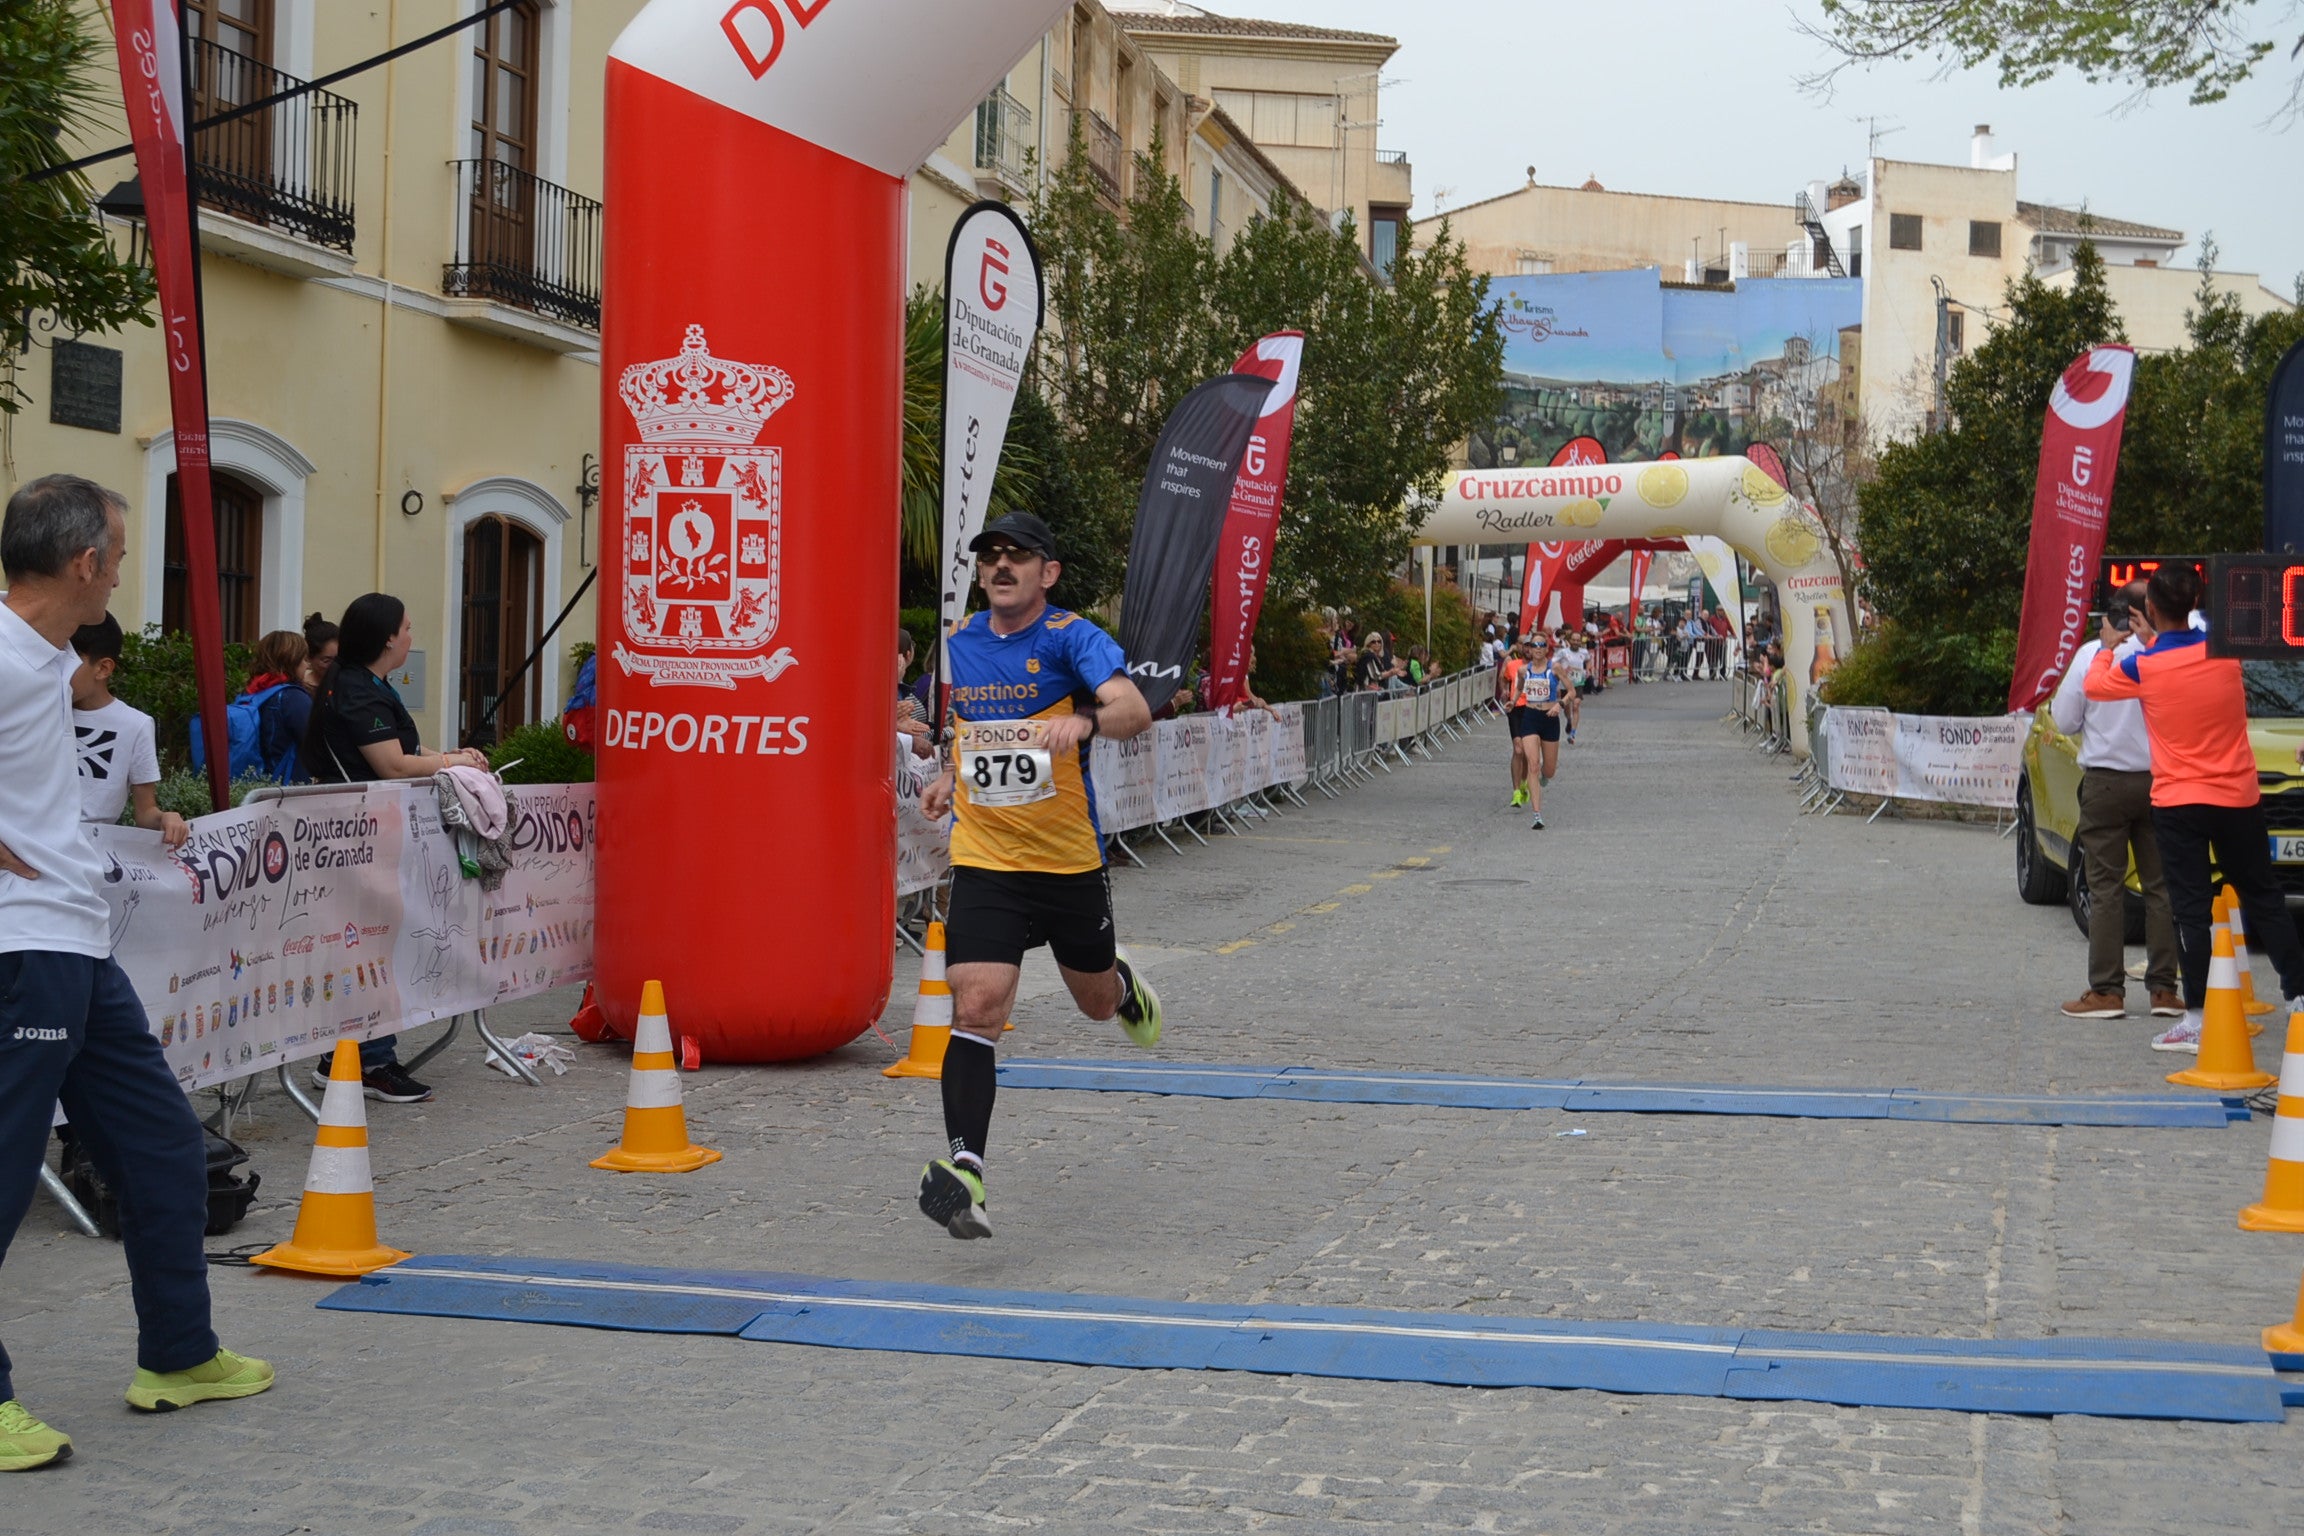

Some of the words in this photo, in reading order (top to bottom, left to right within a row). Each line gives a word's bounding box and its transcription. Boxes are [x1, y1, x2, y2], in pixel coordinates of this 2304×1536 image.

[954, 298, 1022, 349] Diputación
[952, 327, 968, 349] de
[970, 333, 1020, 374] Granada
[1166, 463, 1188, 478] that
[1170, 446, 1228, 472] Movement
[1160, 478, 1202, 498] inspires
[1459, 474, 1623, 500] Cruzcampo
[2057, 481, 2103, 506] Diputación
[2056, 495, 2067, 507] de
[2067, 498, 2103, 518] Granada
[1476, 507, 1556, 533] Radler
[659, 668, 722, 681] GRANADA
[605, 709, 810, 756] DEPORTES
[1939, 727, 1982, 746] FONDO
[973, 753, 1037, 789] 879
[294, 811, 378, 848] Diputación
[266, 846, 283, 867] 24
[295, 847, 310, 871] de
[315, 841, 374, 869] Granada
